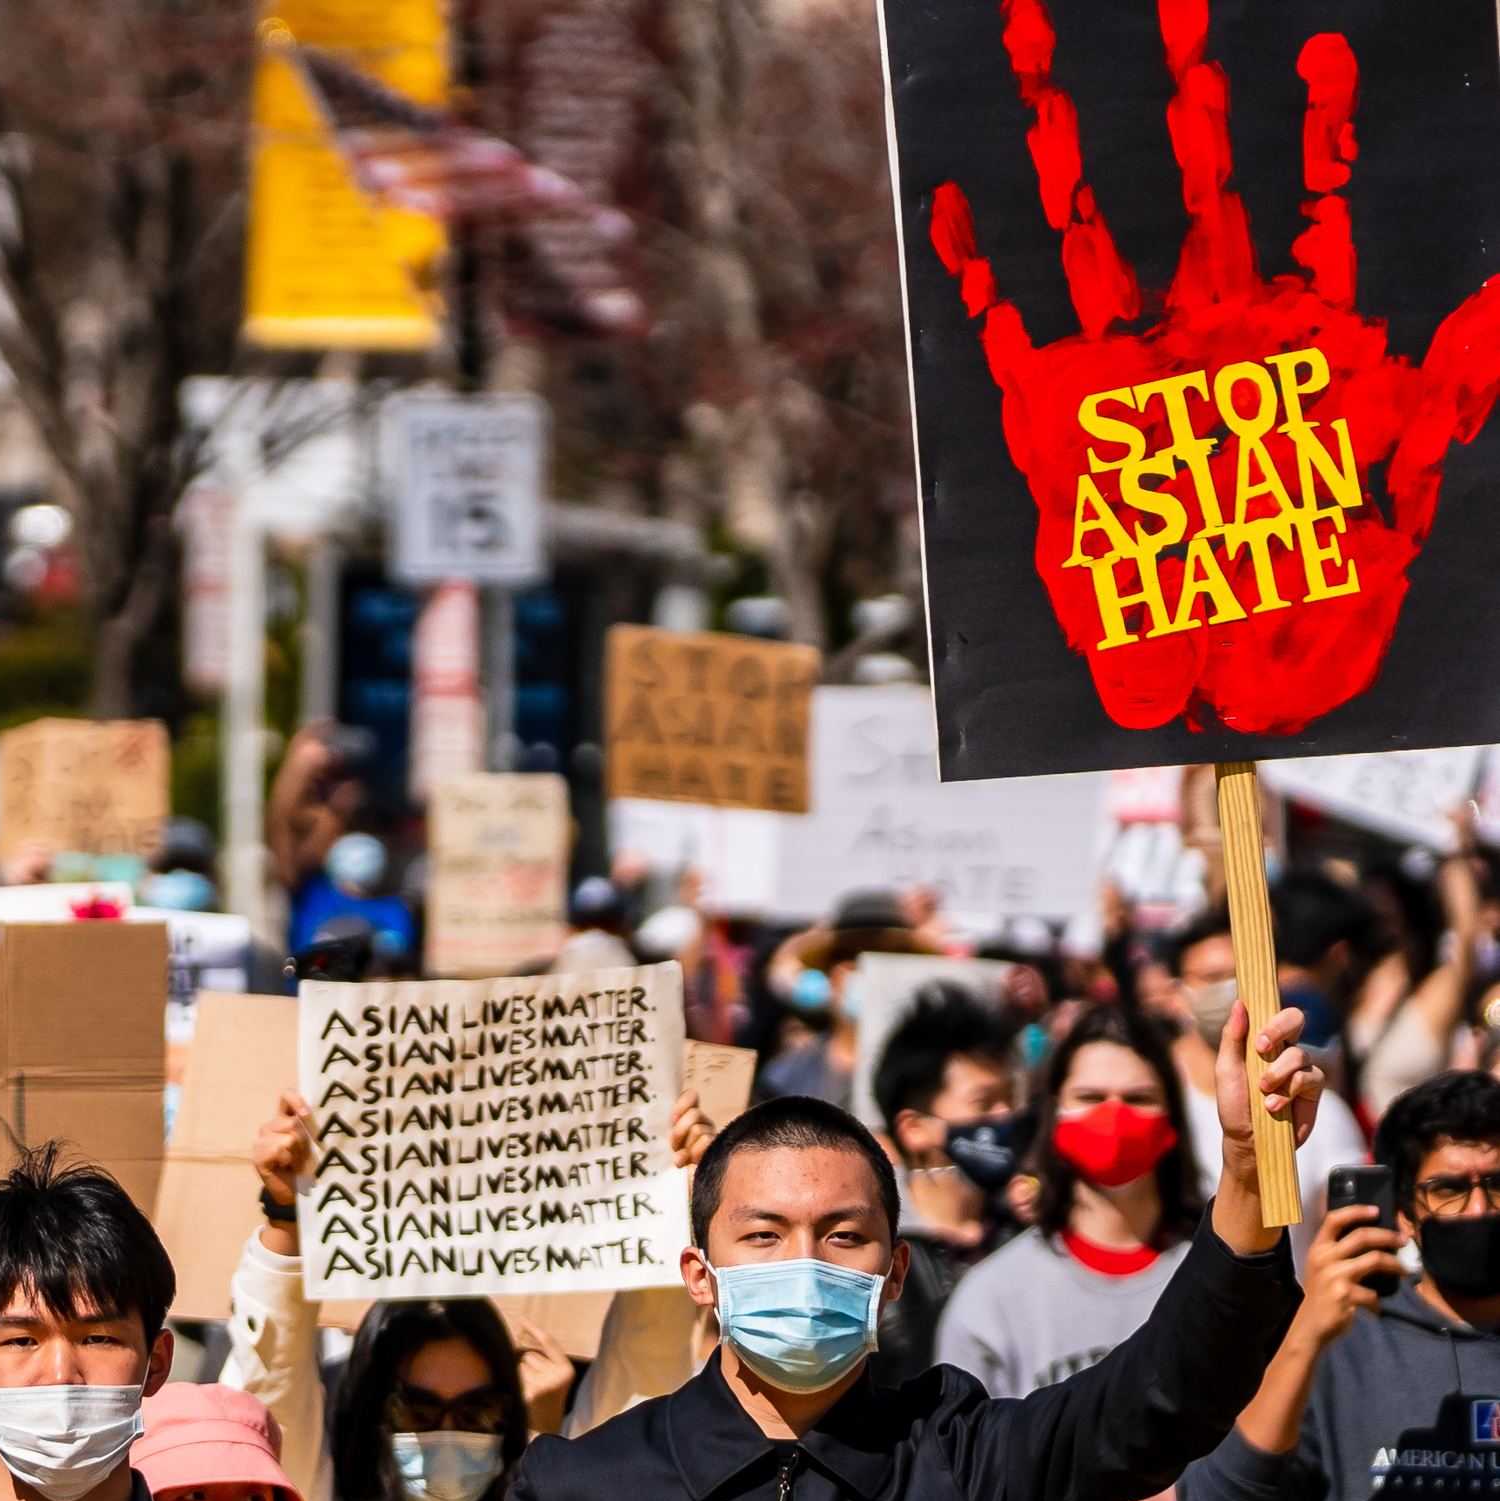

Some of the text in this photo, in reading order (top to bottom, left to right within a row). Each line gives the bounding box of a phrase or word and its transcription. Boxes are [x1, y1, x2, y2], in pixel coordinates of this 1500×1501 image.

[1077, 347, 1330, 473] STOP
[1061, 418, 1363, 568] ASIAN
[1081, 506, 1362, 651] HATE
[321, 986, 657, 1039] ASIAN LIVES MATTER.
[321, 1018, 656, 1073] ASIAN LIVES MATTER.
[320, 1068, 455, 1107] ASIAN
[460, 1059, 536, 1092] LIVES
[541, 1050, 653, 1081] MATTER.
[317, 1075, 658, 1142] ASIAN LIVES MATTER.
[316, 1116, 657, 1178] ASIAN LIVES MATTER.
[317, 1151, 658, 1212] ASIAN LIVES MATTER.
[321, 1192, 663, 1245] ASIAN LIVES MATTER.
[323, 1237, 664, 1280] ASIAN LIVES MATTER.
[1371, 1447, 1484, 1469] AMERICAN
